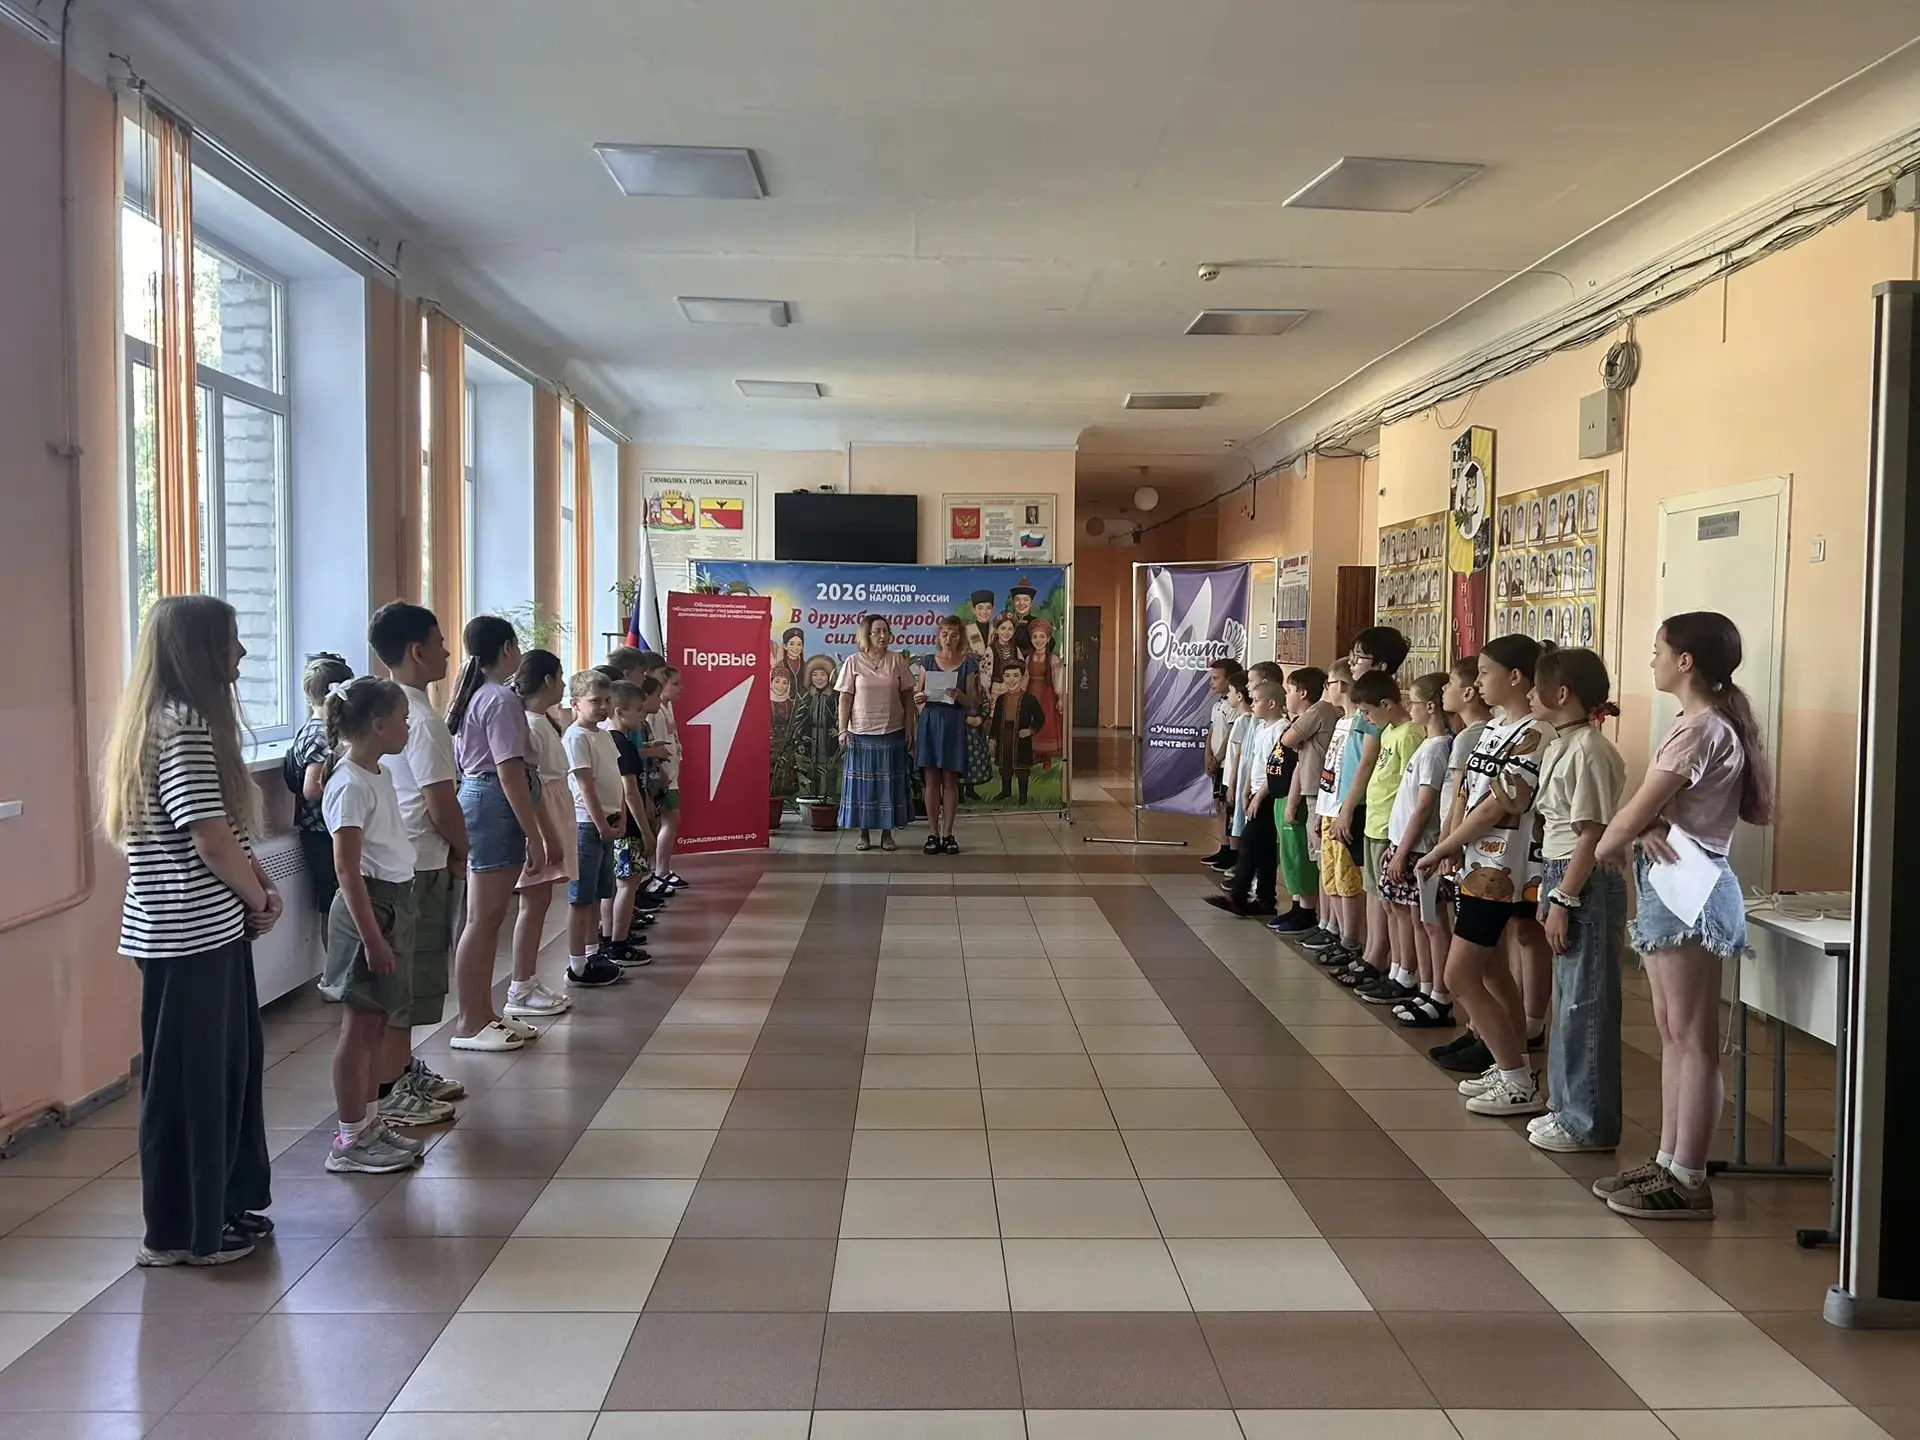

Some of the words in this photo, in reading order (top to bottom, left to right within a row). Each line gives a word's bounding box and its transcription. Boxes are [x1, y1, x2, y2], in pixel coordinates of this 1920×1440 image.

[689, 477, 712, 485] ГОРОДА
[816, 582, 867, 601] 2026
[869, 583, 917, 593] ЕДИНСТВО
[869, 593, 912, 604] НАРОДОВ
[915, 594, 950, 603] РОССИИ
[788, 608, 802, 624] В
[807, 608, 868, 629] дружб
[886, 609, 945, 630] народо
[824, 632, 857, 646] сил
[888, 632, 937, 646] оссии
[1151, 621, 1229, 662] Орлята
[683, 648, 756, 671] Первые
[1150, 725, 1199, 736] «Учимся,
[1150, 739, 1196, 748] мечтаем
[677, 832, 758, 845] будьвдвижении.рф
